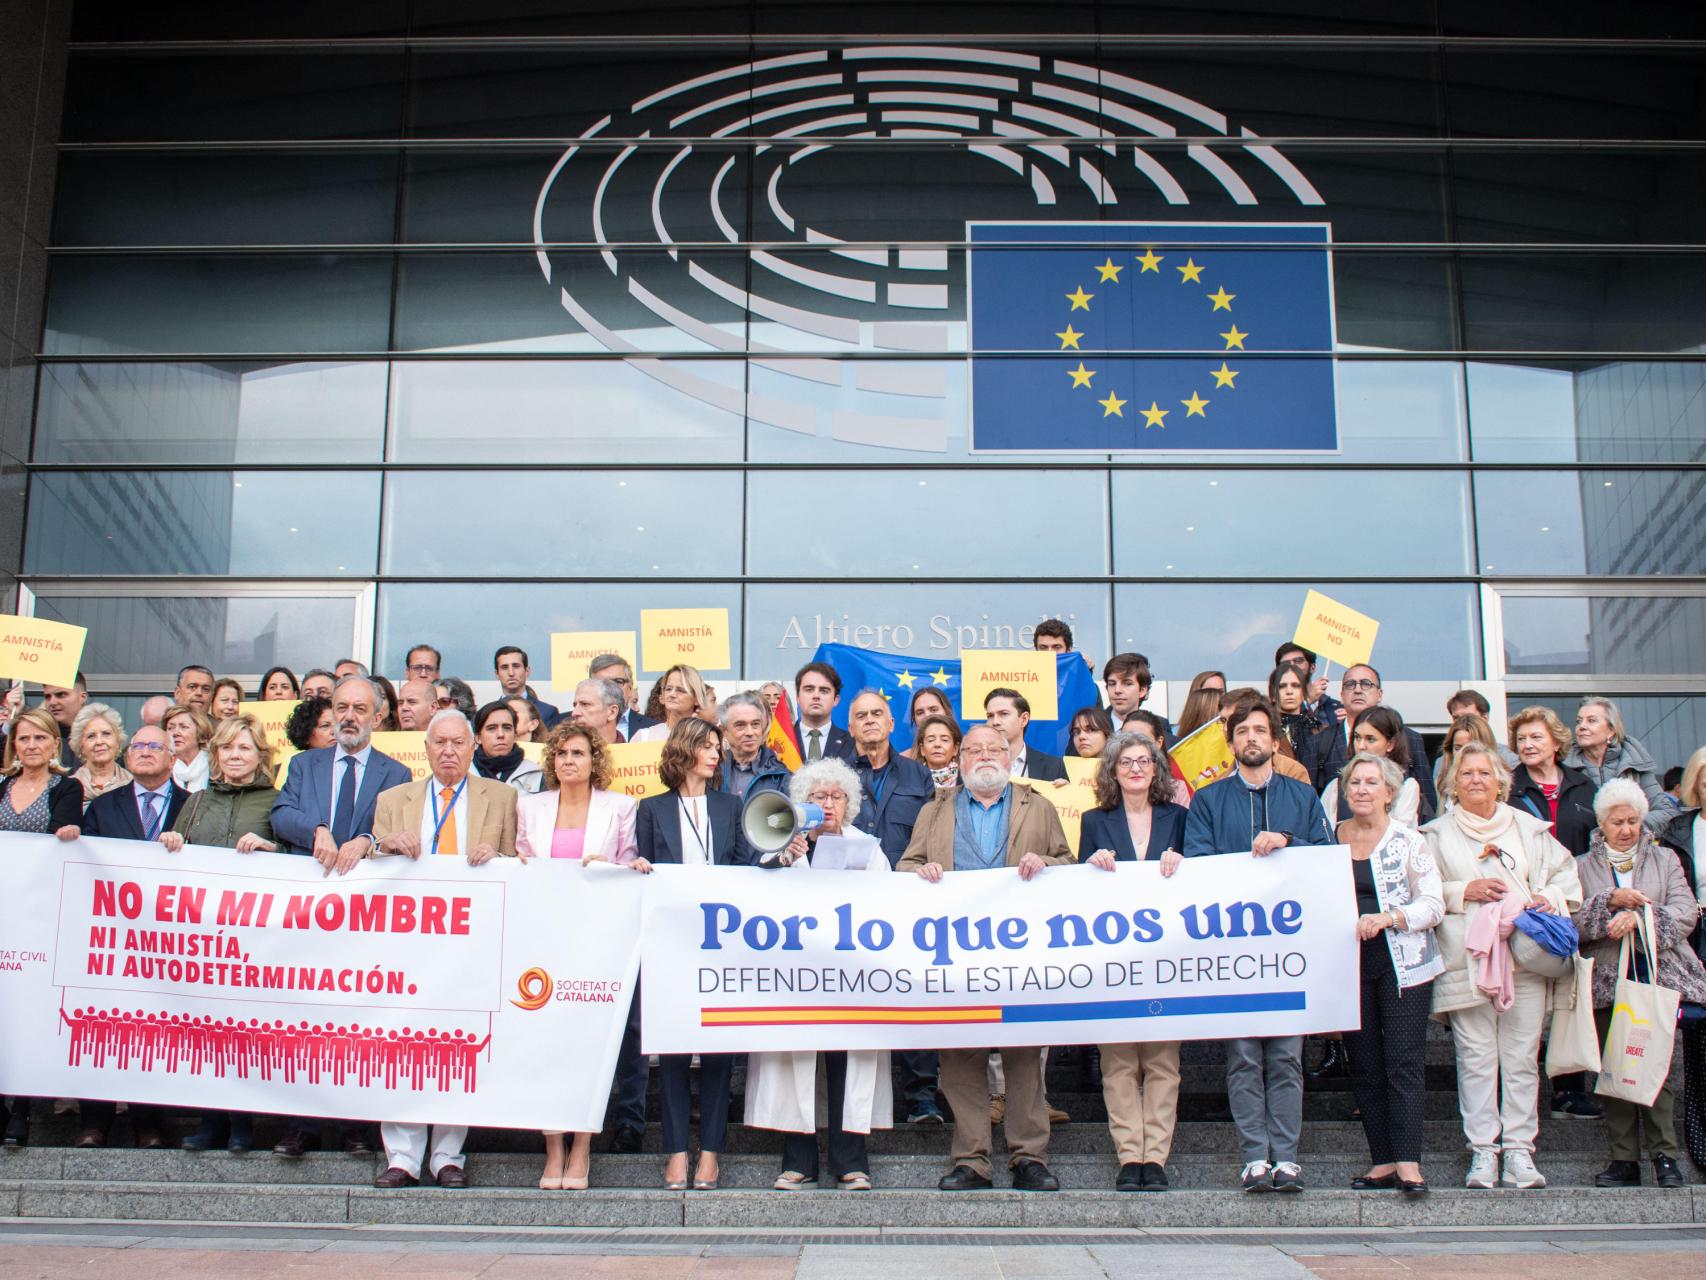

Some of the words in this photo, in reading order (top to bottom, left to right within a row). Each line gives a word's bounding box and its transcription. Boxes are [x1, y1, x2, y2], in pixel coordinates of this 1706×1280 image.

[659, 625, 713, 638] AMNISTÍA
[777, 614, 914, 650] Altiero
[1316, 613, 1361, 640] AMNISTÍA
[2, 634, 63, 652] AMNISTÍA
[1327, 633, 1343, 646] NO
[677, 643, 695, 652] NO
[19, 652, 39, 663] NO
[980, 669, 1039, 683] AMNISTÍA
[612, 761, 659, 778] MNISTÍ
[625, 784, 646, 796] NO
[92, 879, 143, 920] NO
[155, 884, 207, 924] EN
[216, 890, 274, 928] MI
[283, 893, 472, 935] NOMBRE
[699, 902, 819, 951] Por
[834, 902, 895, 951] lo
[912, 915, 1029, 966] que
[1046, 908, 1164, 949] nos
[1179, 899, 1303, 941] une
[89, 926, 117, 949] NI
[124, 928, 251, 963] AMNISTÍA,
[20, 951, 48, 962] CIVIL
[87, 953, 115, 976] NI
[122, 955, 418, 995] AUTODETERMINACIÓN.
[698, 967, 912, 993] DEFENDEMOS
[925, 967, 955, 993] EL
[966, 963, 1093, 992] ESTADO
[1105, 960, 1144, 987] DE
[1155, 952, 1307, 984] DERECHO
[556, 979, 607, 992] SOCIETAT
[556, 991, 615, 1003] CATALANA
